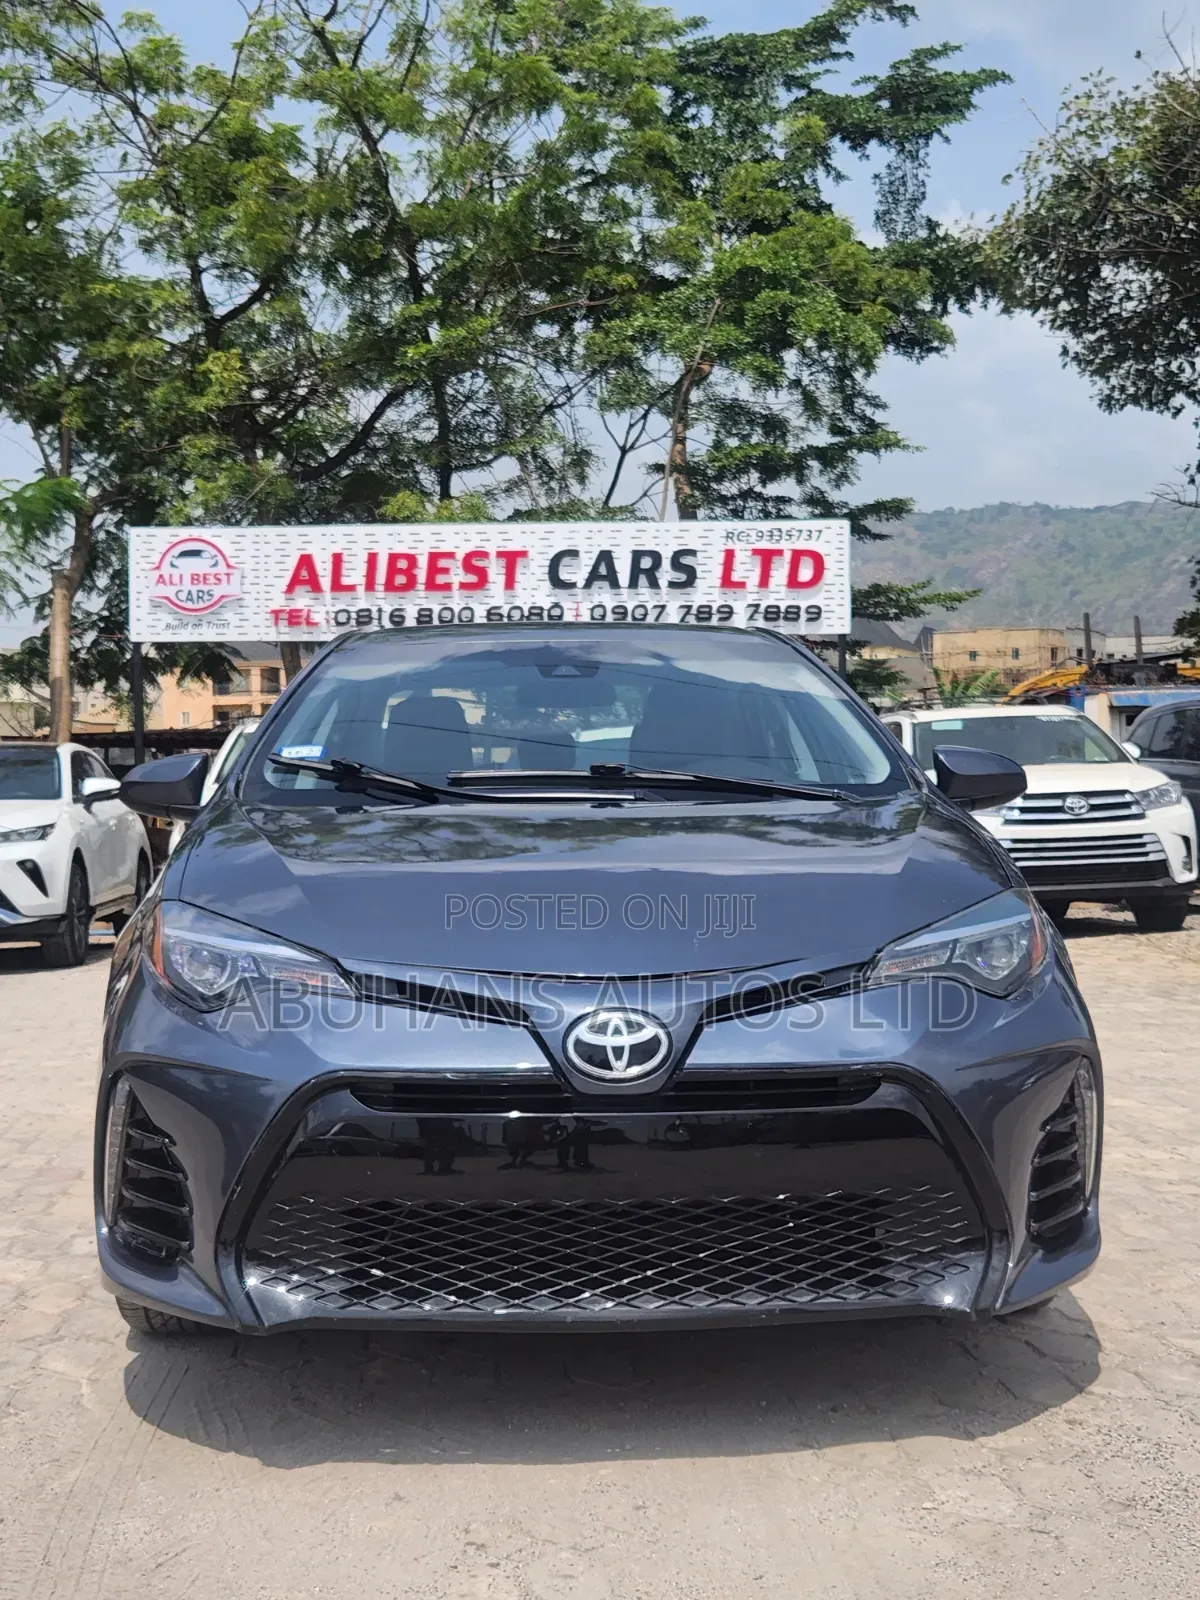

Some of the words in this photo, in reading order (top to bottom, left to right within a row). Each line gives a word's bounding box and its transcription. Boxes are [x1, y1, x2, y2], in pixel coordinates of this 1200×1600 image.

[284, 550, 528, 594] ALIBEST
[547, 549, 697, 590] CARS
[719, 548, 825, 590] LTD
[155, 573, 184, 587] ALI
[190, 572, 234, 586] BEST
[175, 589, 214, 605] CARS
[334, 606, 406, 627] 0816
[415, 605, 475, 625] 800
[486, 604, 565, 623] 6080
[589, 602, 667, 623] 0907
[677, 604, 733, 624] 789
[746, 603, 823, 623] 7889
[164, 621, 189, 631] Build
[191, 622, 203, 630] on
[206, 621, 231, 630] Trust
